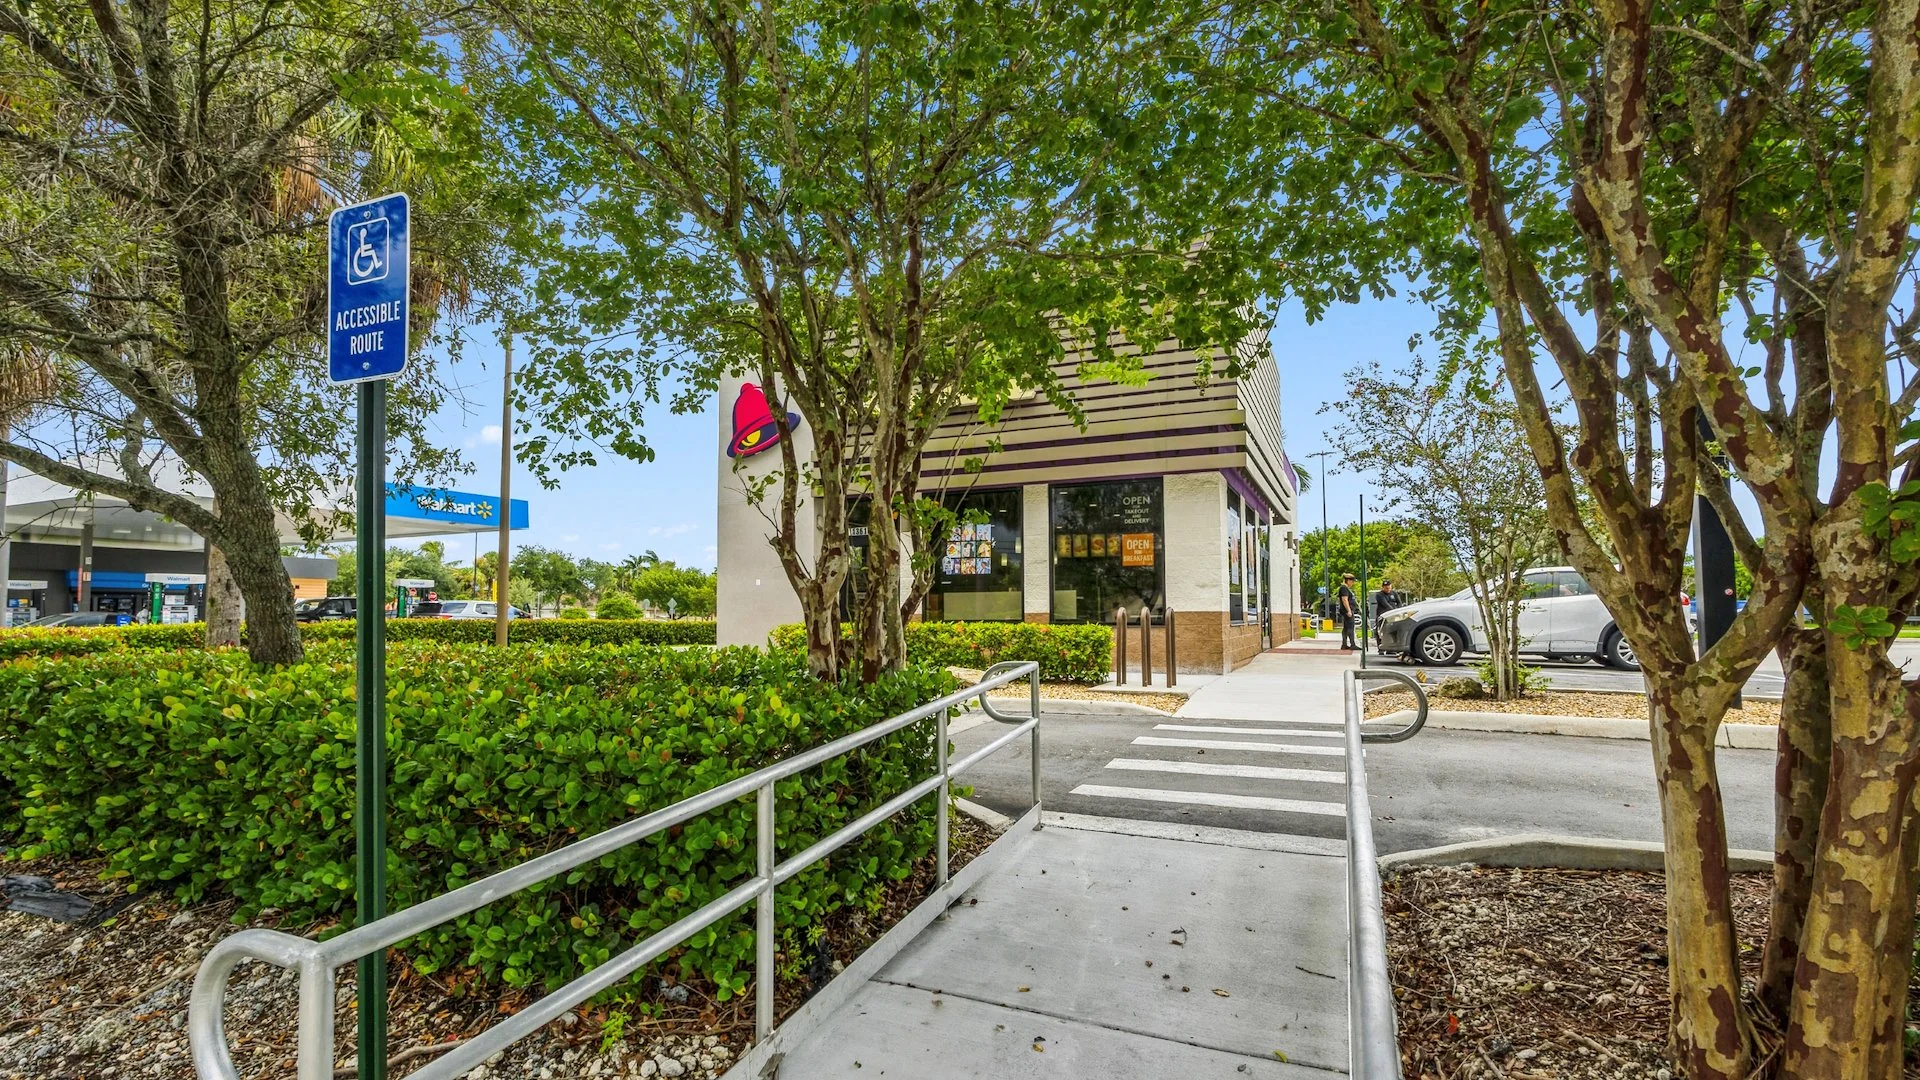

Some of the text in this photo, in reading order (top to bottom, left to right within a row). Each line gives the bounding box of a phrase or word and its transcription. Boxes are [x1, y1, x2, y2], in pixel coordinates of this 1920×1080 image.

[335, 300, 401, 332] ACCESSIBLE
[350, 330, 385, 356] ROUTE
[1122, 496, 1151, 506] OPEN
[1126, 540, 1150, 550] OPEN
